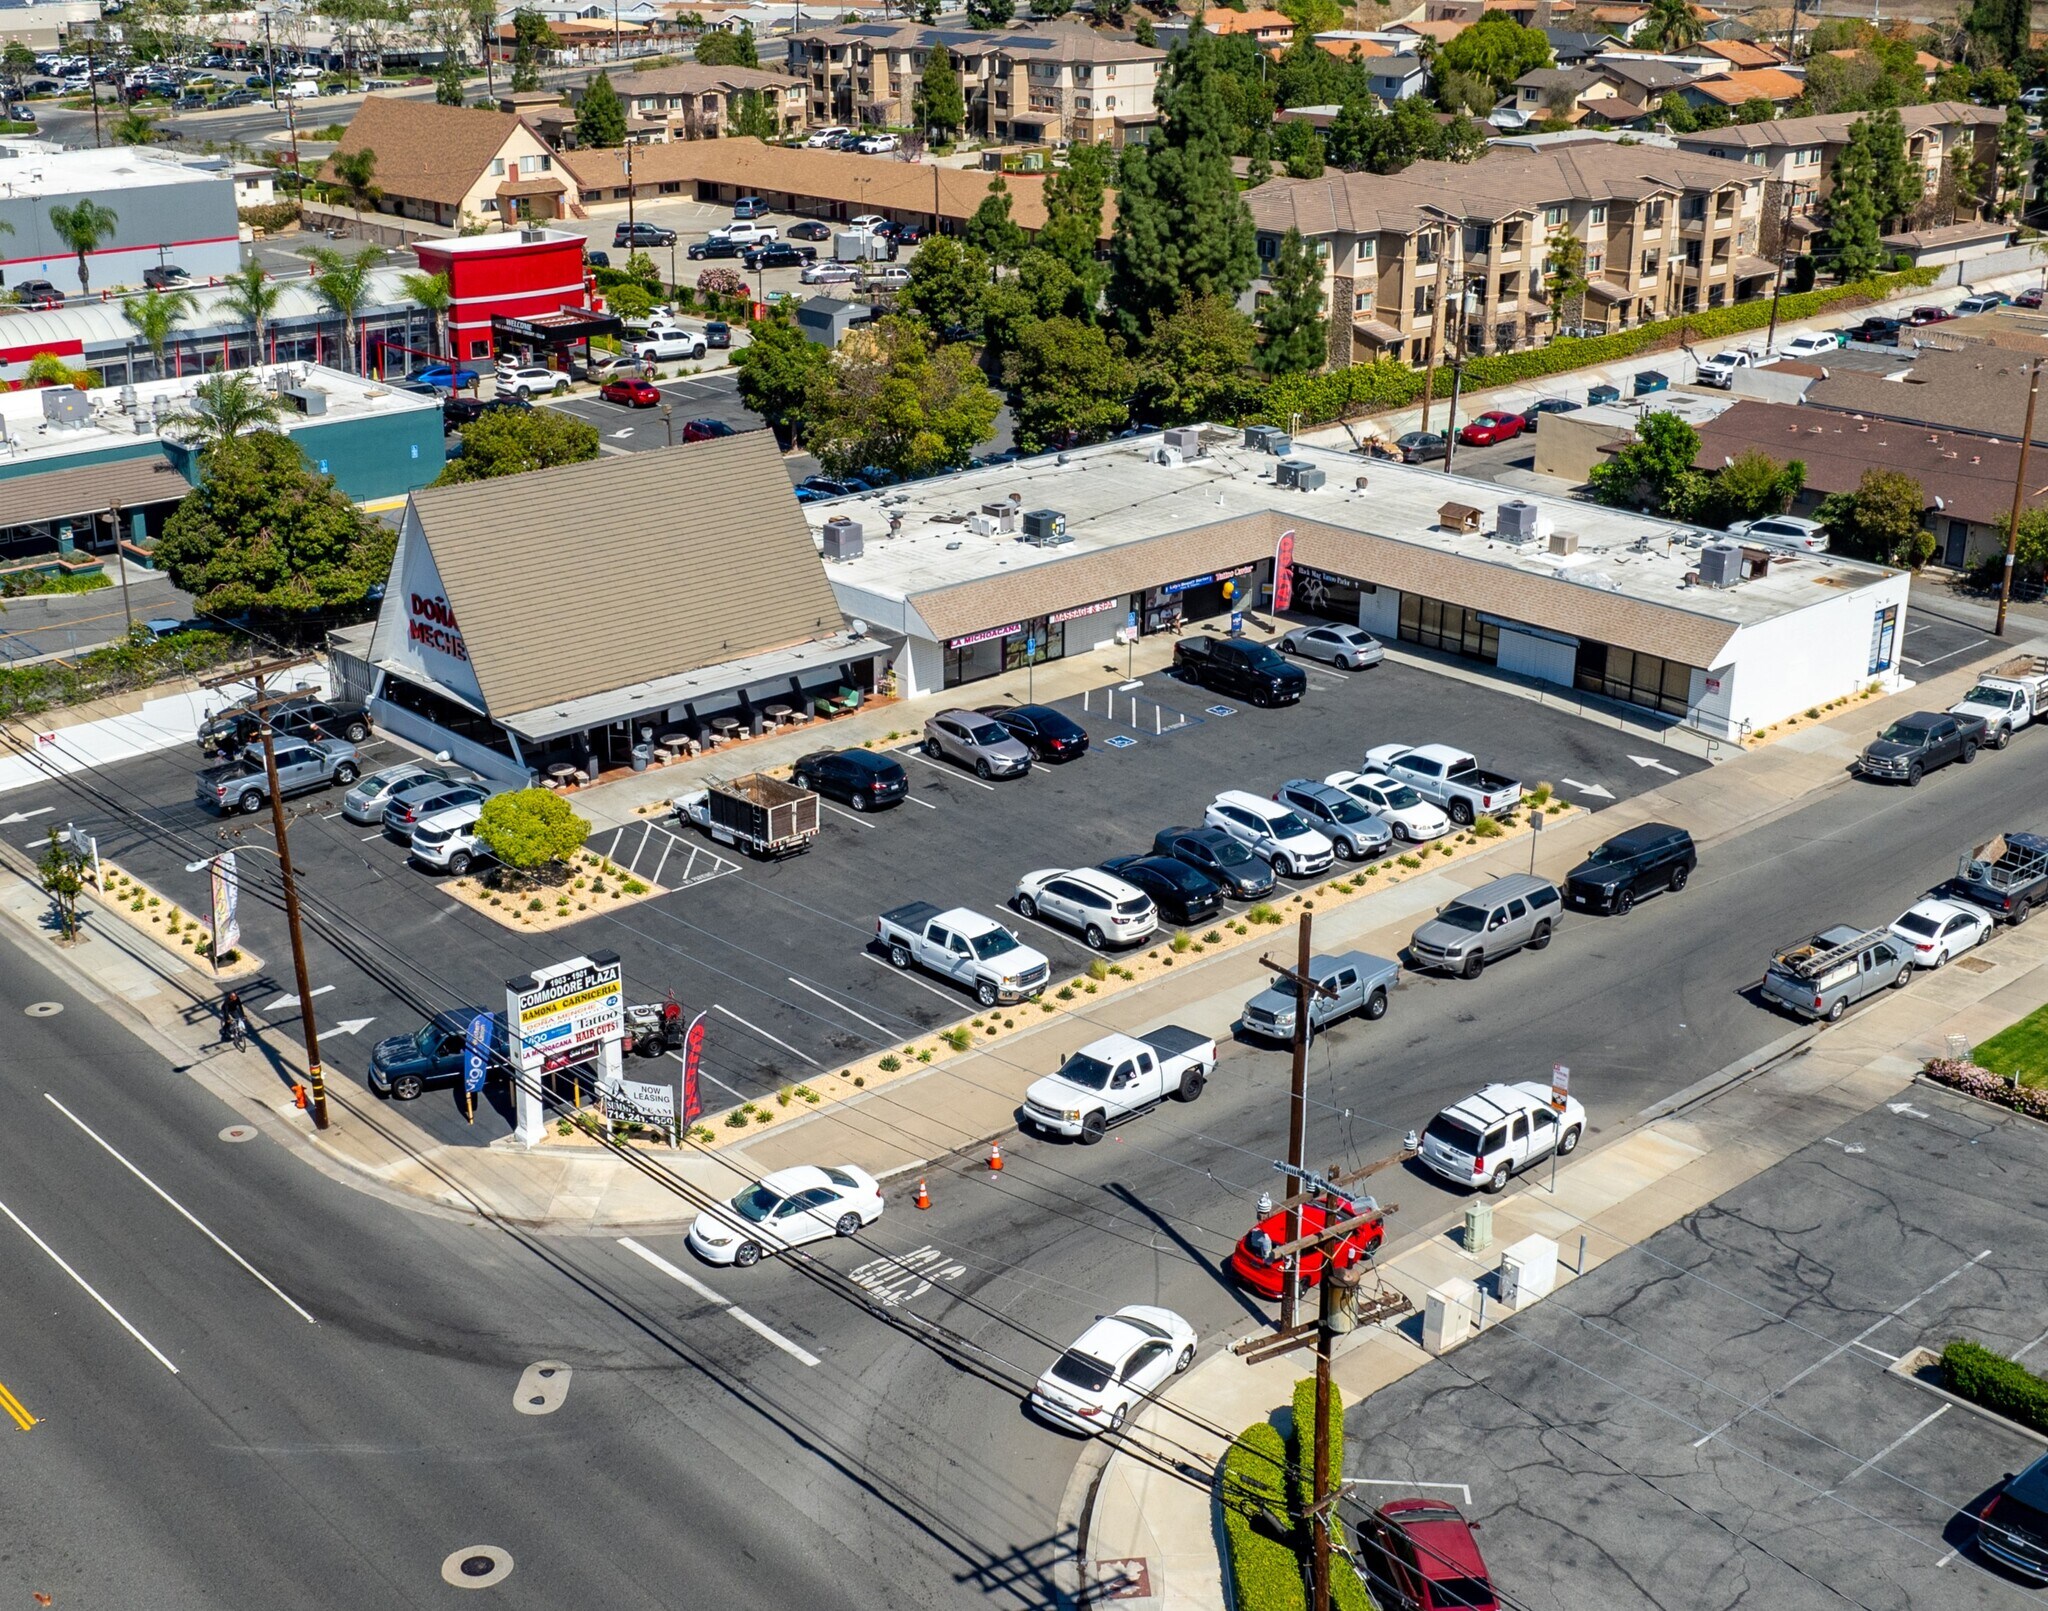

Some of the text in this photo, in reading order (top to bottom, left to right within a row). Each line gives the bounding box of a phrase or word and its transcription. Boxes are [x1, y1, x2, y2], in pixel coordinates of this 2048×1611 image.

[1053, 606, 1091, 622] MASSAGE
[1098, 600, 1114, 611] SPA
[409, 618, 467, 662] MECHE
[951, 623, 1021, 647] LA MICHOACANA
[520, 968, 617, 1008] COMMODORE PLAZA
[522, 984, 618, 1021] RAMONA CARNICERIA
[577, 1011, 618, 1029] Tattoo
[575, 1028, 595, 1043] HAIR
[596, 1022, 616, 1035] CUTS
[633, 1092, 671, 1103] LEASING
[641, 1085, 661, 1094] NOW
[848, 1244, 967, 1307] STOP
